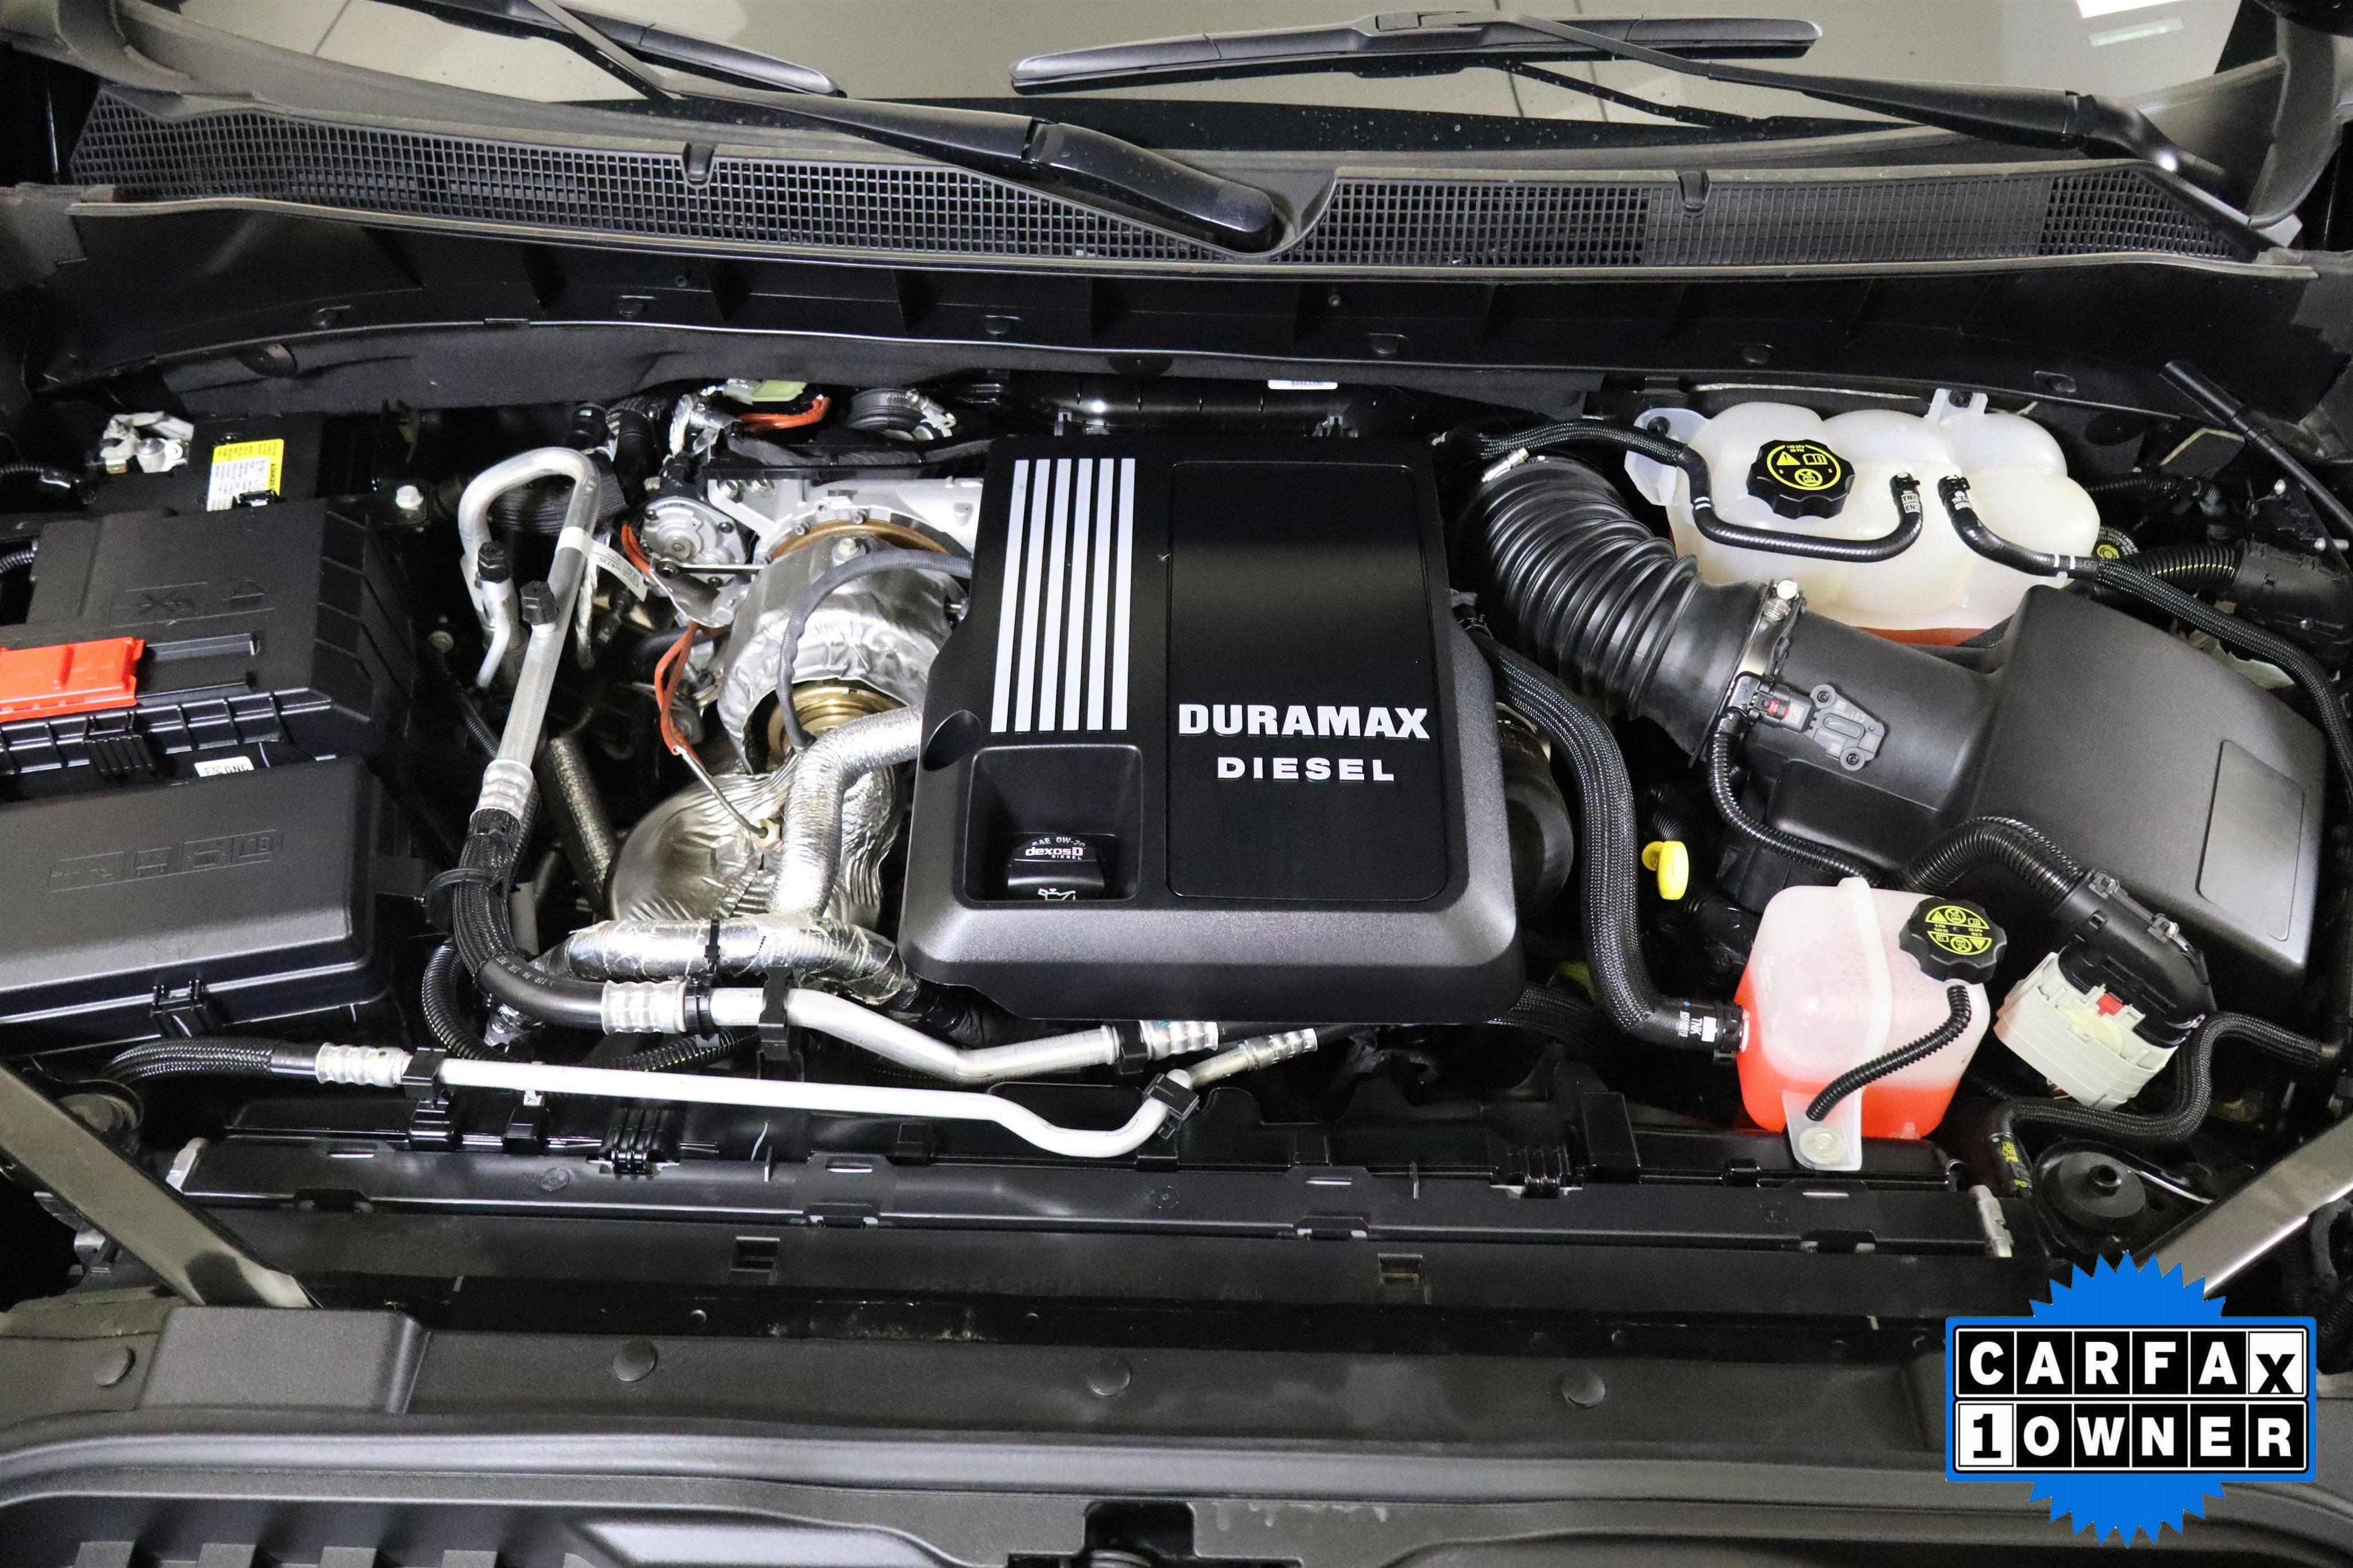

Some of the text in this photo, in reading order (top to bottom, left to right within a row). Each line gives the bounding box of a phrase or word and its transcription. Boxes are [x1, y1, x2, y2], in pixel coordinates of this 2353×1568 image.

[1179, 704, 1429, 739] DURAMAX
[1218, 757, 1394, 782] DIESEL
[1690, 1018, 1703, 1036] TNK
